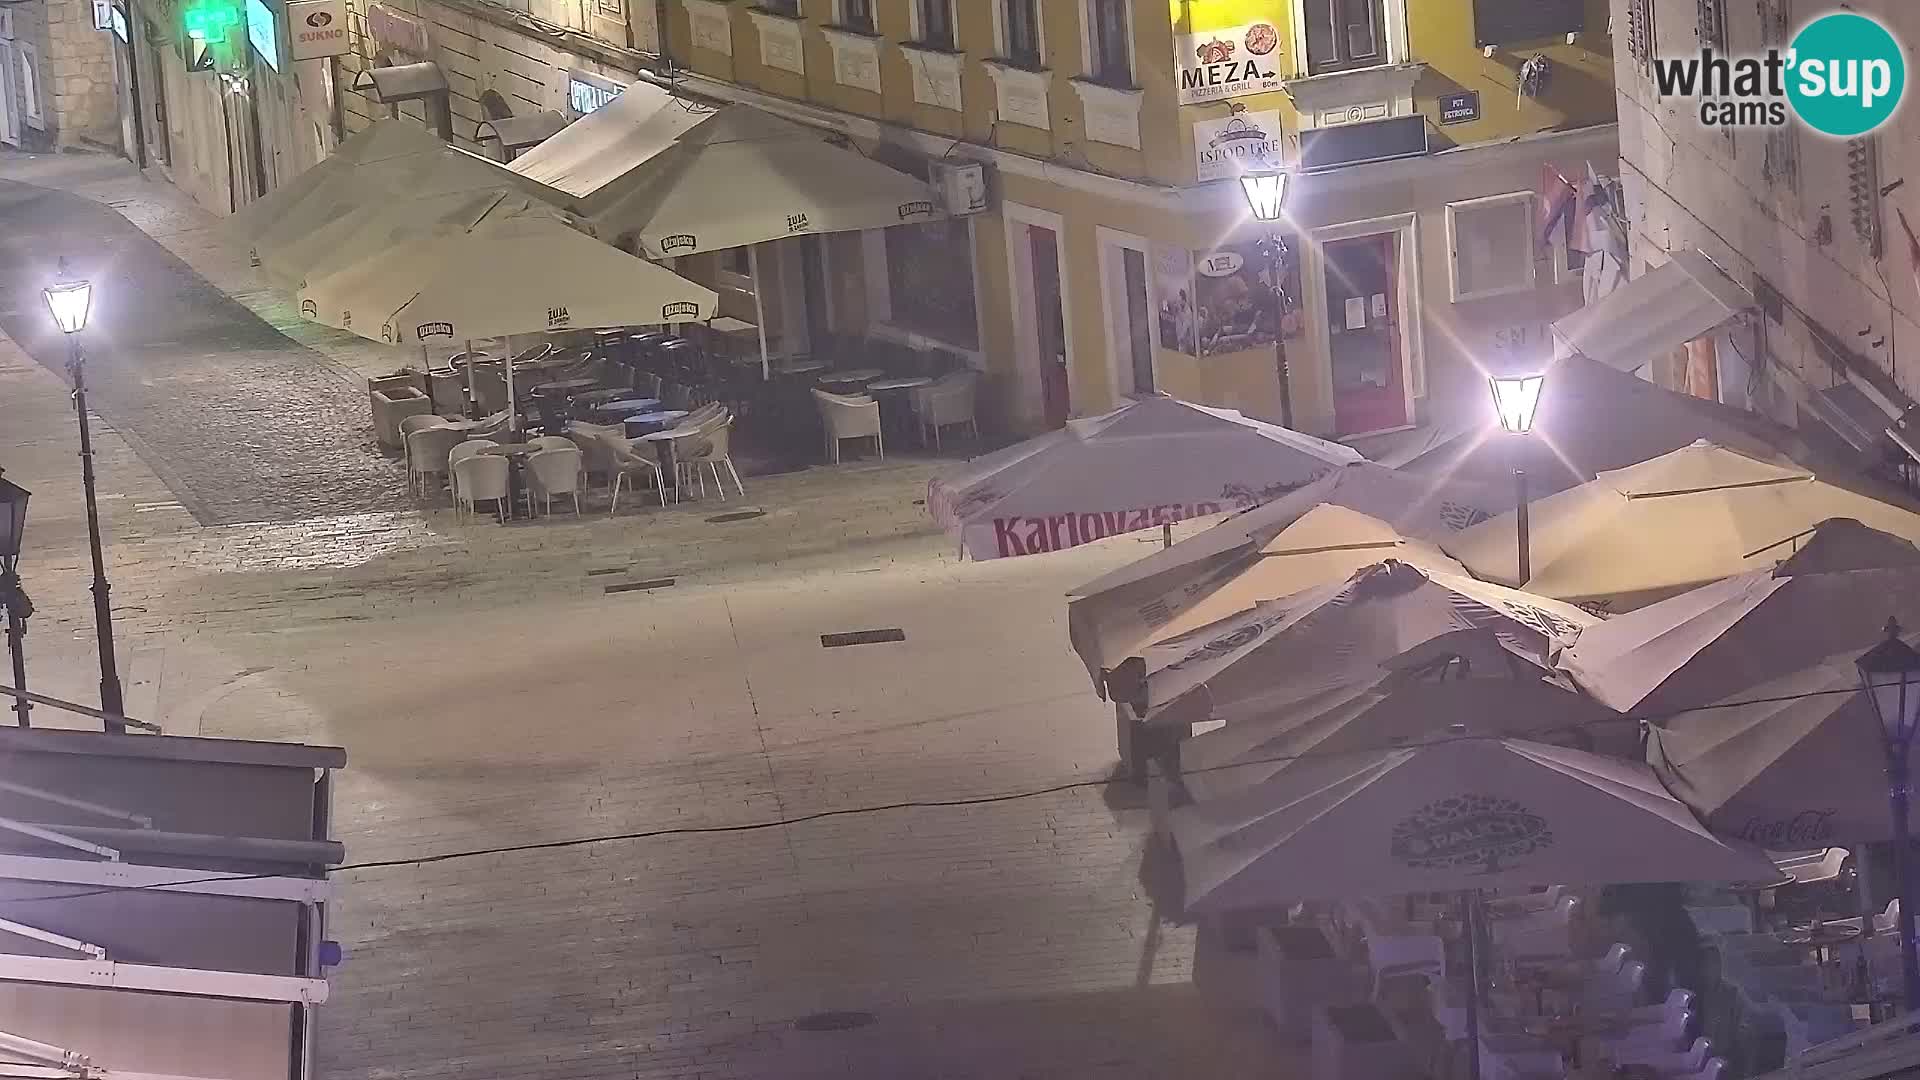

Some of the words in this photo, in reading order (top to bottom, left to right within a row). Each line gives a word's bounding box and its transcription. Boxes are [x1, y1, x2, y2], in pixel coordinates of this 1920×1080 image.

[300, 29, 343, 41] SUKNO
[1182, 60, 1260, 90] MEZA
[1191, 85, 1224, 98] PIZZERIA
[1231, 82, 1252, 92] GRILL
[1200, 146, 1245, 163] ISPOD
